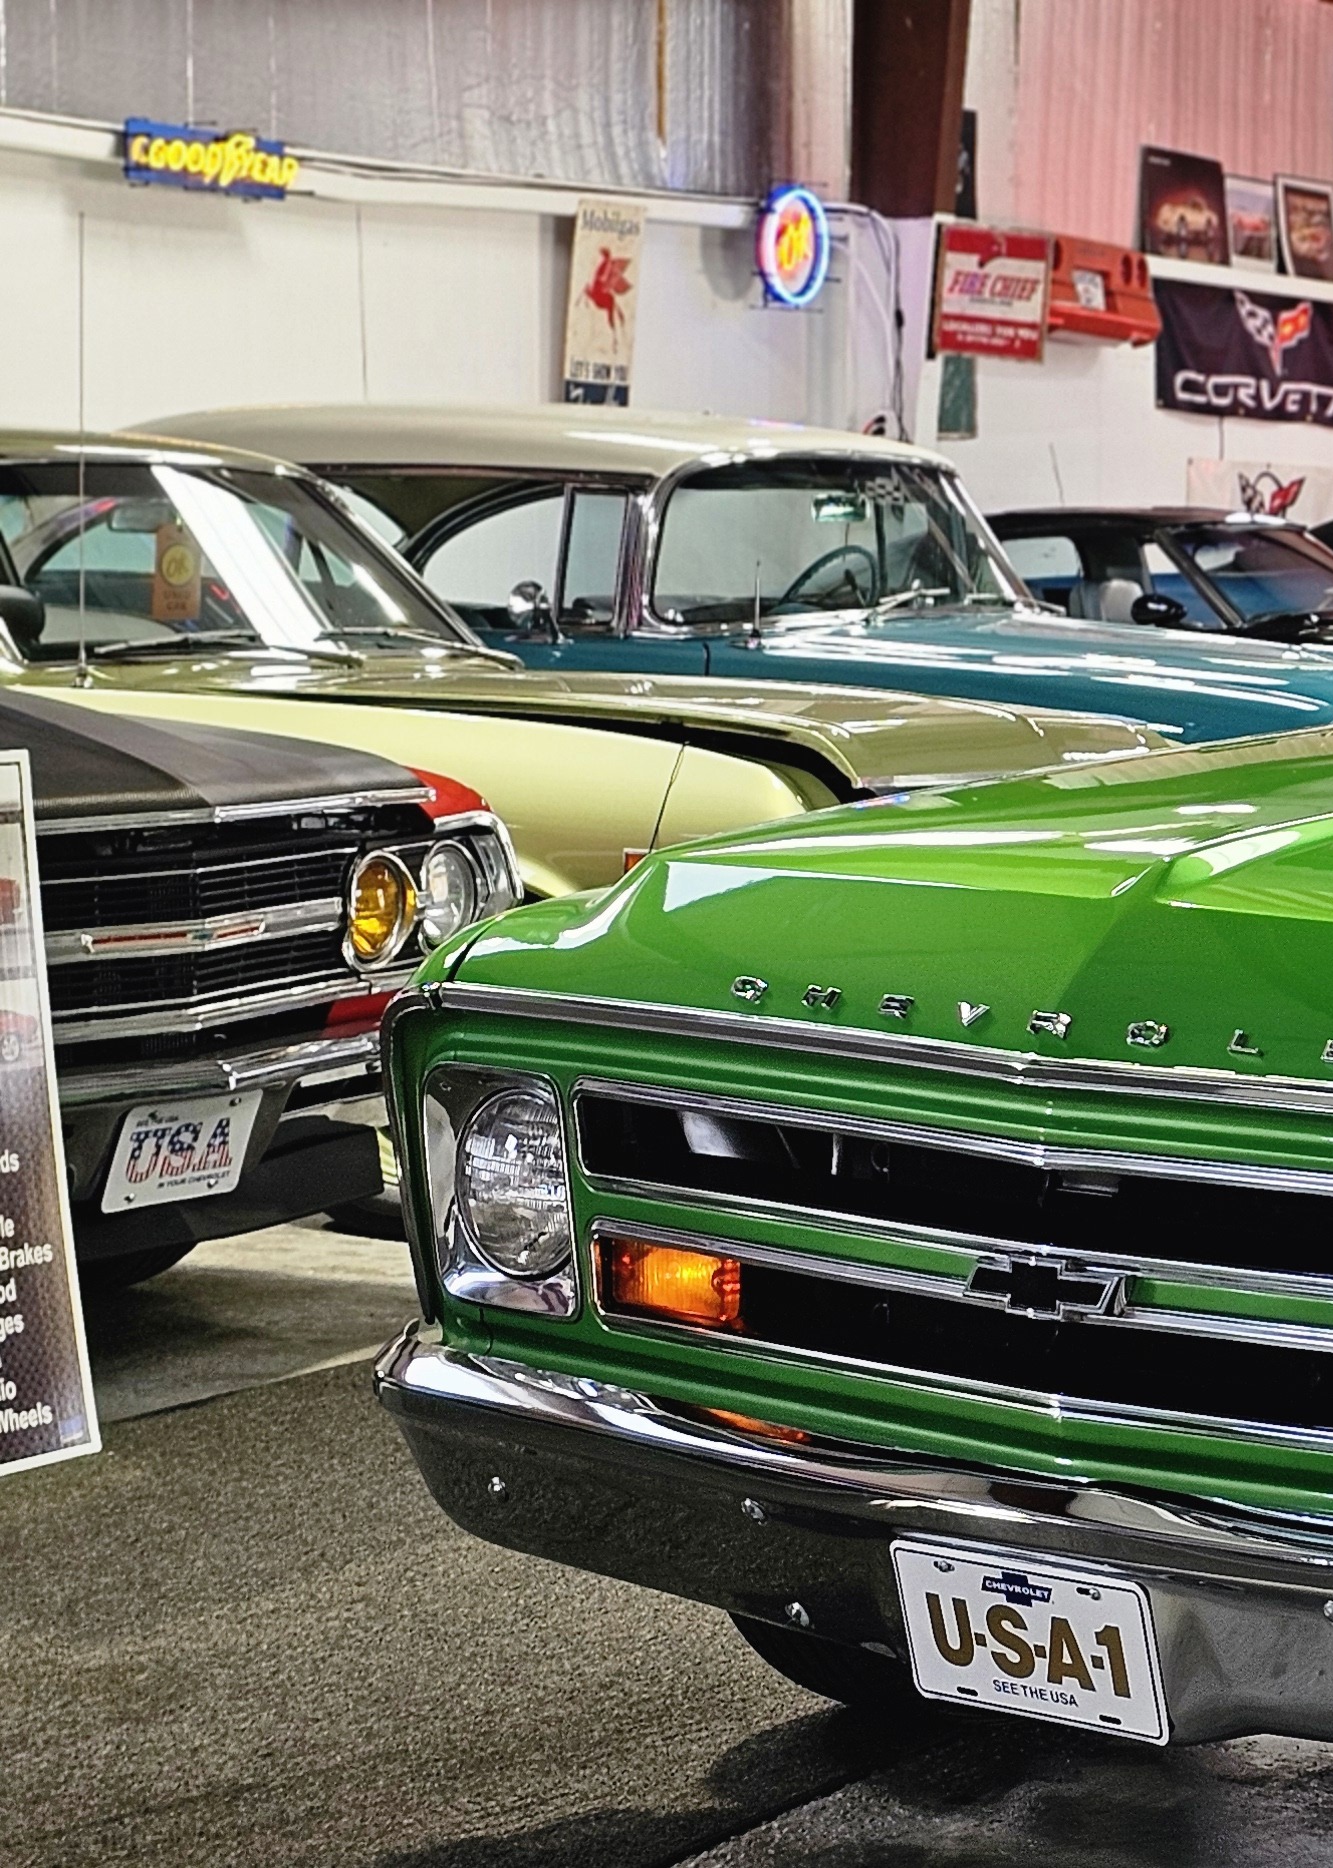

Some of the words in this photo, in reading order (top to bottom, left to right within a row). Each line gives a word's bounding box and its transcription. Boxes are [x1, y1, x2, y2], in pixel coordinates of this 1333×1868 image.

[130, 133, 299, 188] GOODYEAR
[582, 208, 640, 241] Mobilgas
[947, 270, 986, 296] FIRE
[989, 273, 1041, 302] CHIEF
[126, 1117, 233, 1184] USA
[985, 1578, 1051, 1600] CHEVROLET
[993, 1679, 1020, 1696] SEE
[1022, 1684, 1050, 1703] THE
[1050, 1689, 1078, 1708] USA
